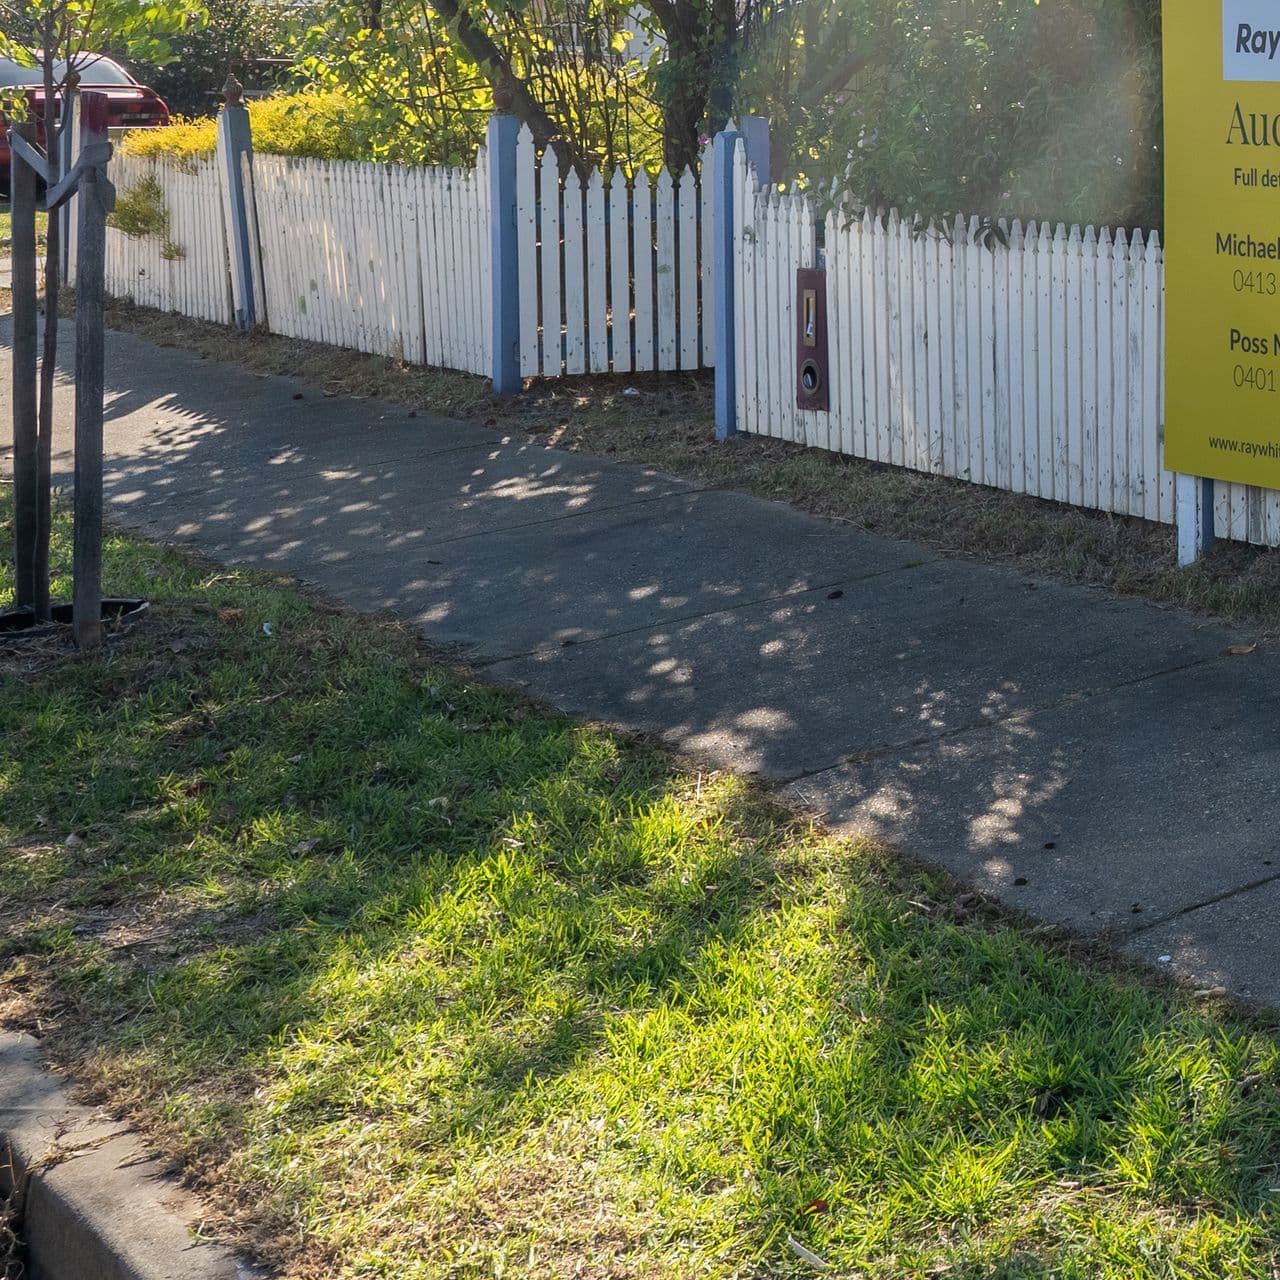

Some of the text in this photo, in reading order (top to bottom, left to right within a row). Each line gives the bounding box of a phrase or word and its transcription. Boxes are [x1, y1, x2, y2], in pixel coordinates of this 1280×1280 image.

[1234, 168, 1257, 186] Full
[1216, 232, 1280, 260] Michael
[1232, 269, 1276, 295] 0413
[1230, 328, 1268, 355] Poss
[1233, 365, 1276, 392] 0401
